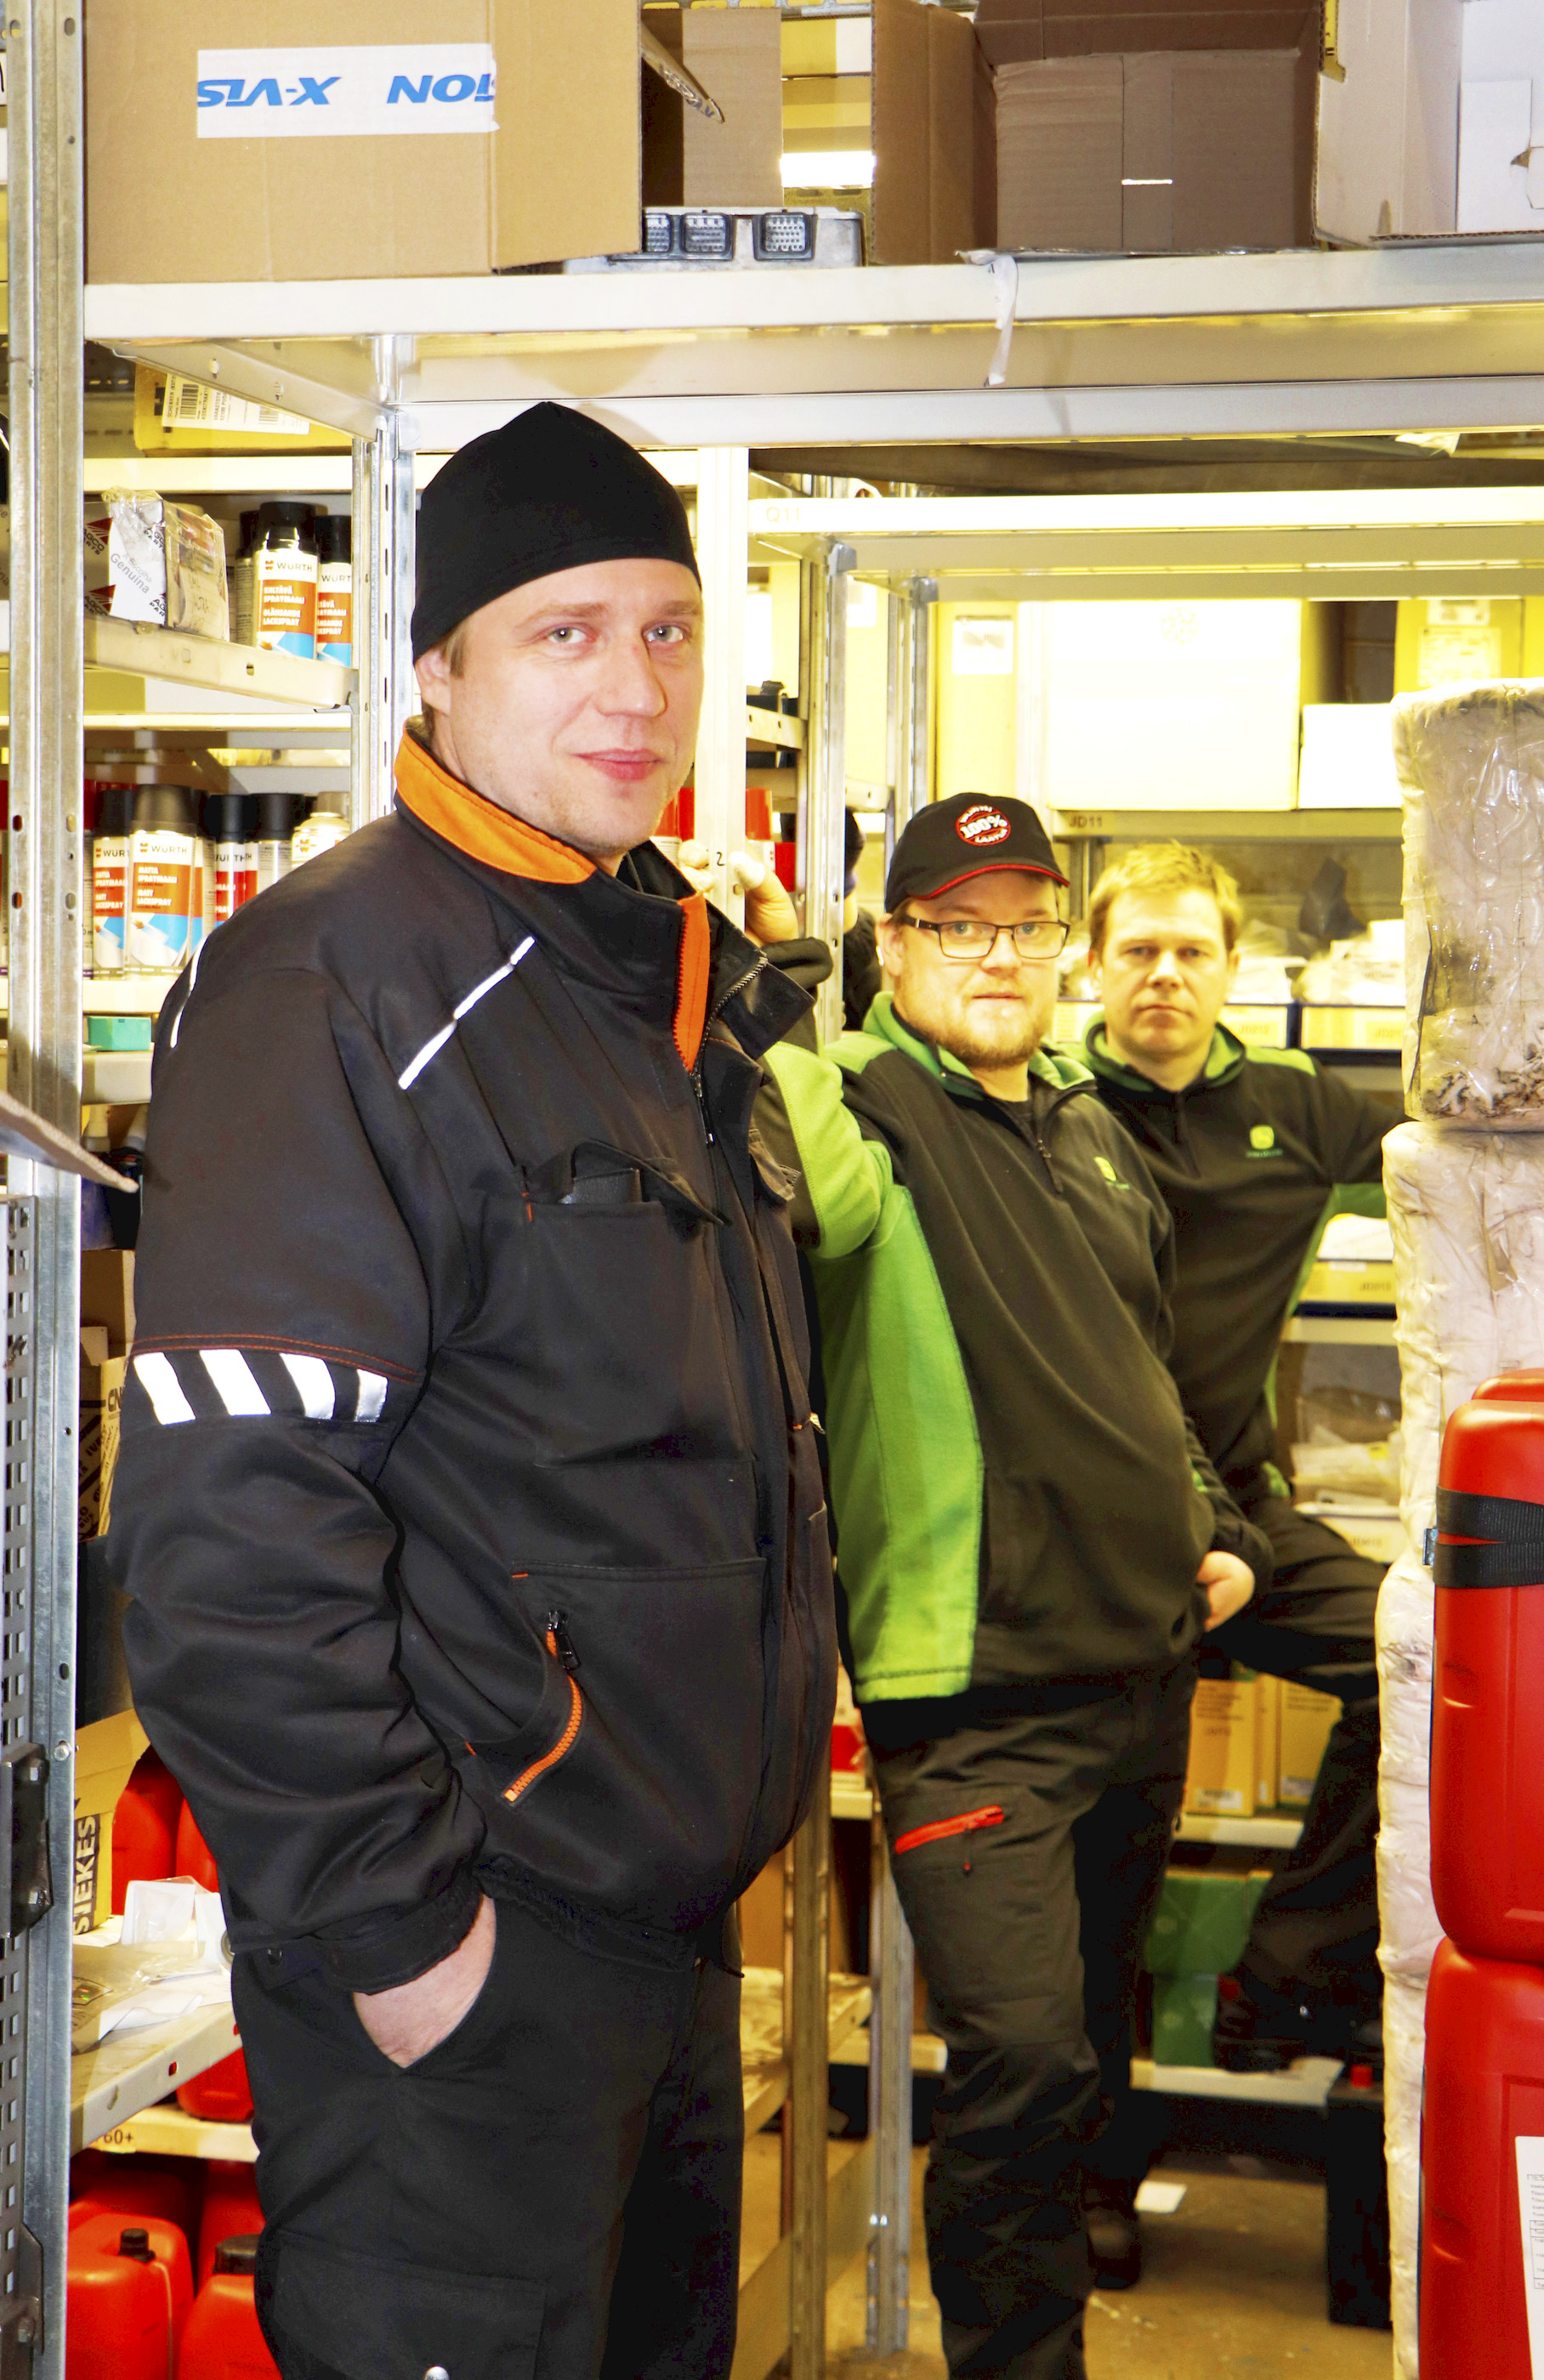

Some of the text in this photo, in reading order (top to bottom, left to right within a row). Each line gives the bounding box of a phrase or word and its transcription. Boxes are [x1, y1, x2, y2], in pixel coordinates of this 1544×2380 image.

[386, 73, 495, 105] ION
[766, 507, 801, 523] Q11
[960, 814, 1008, 839] 100%
[1069, 815, 1103, 829] JD11
